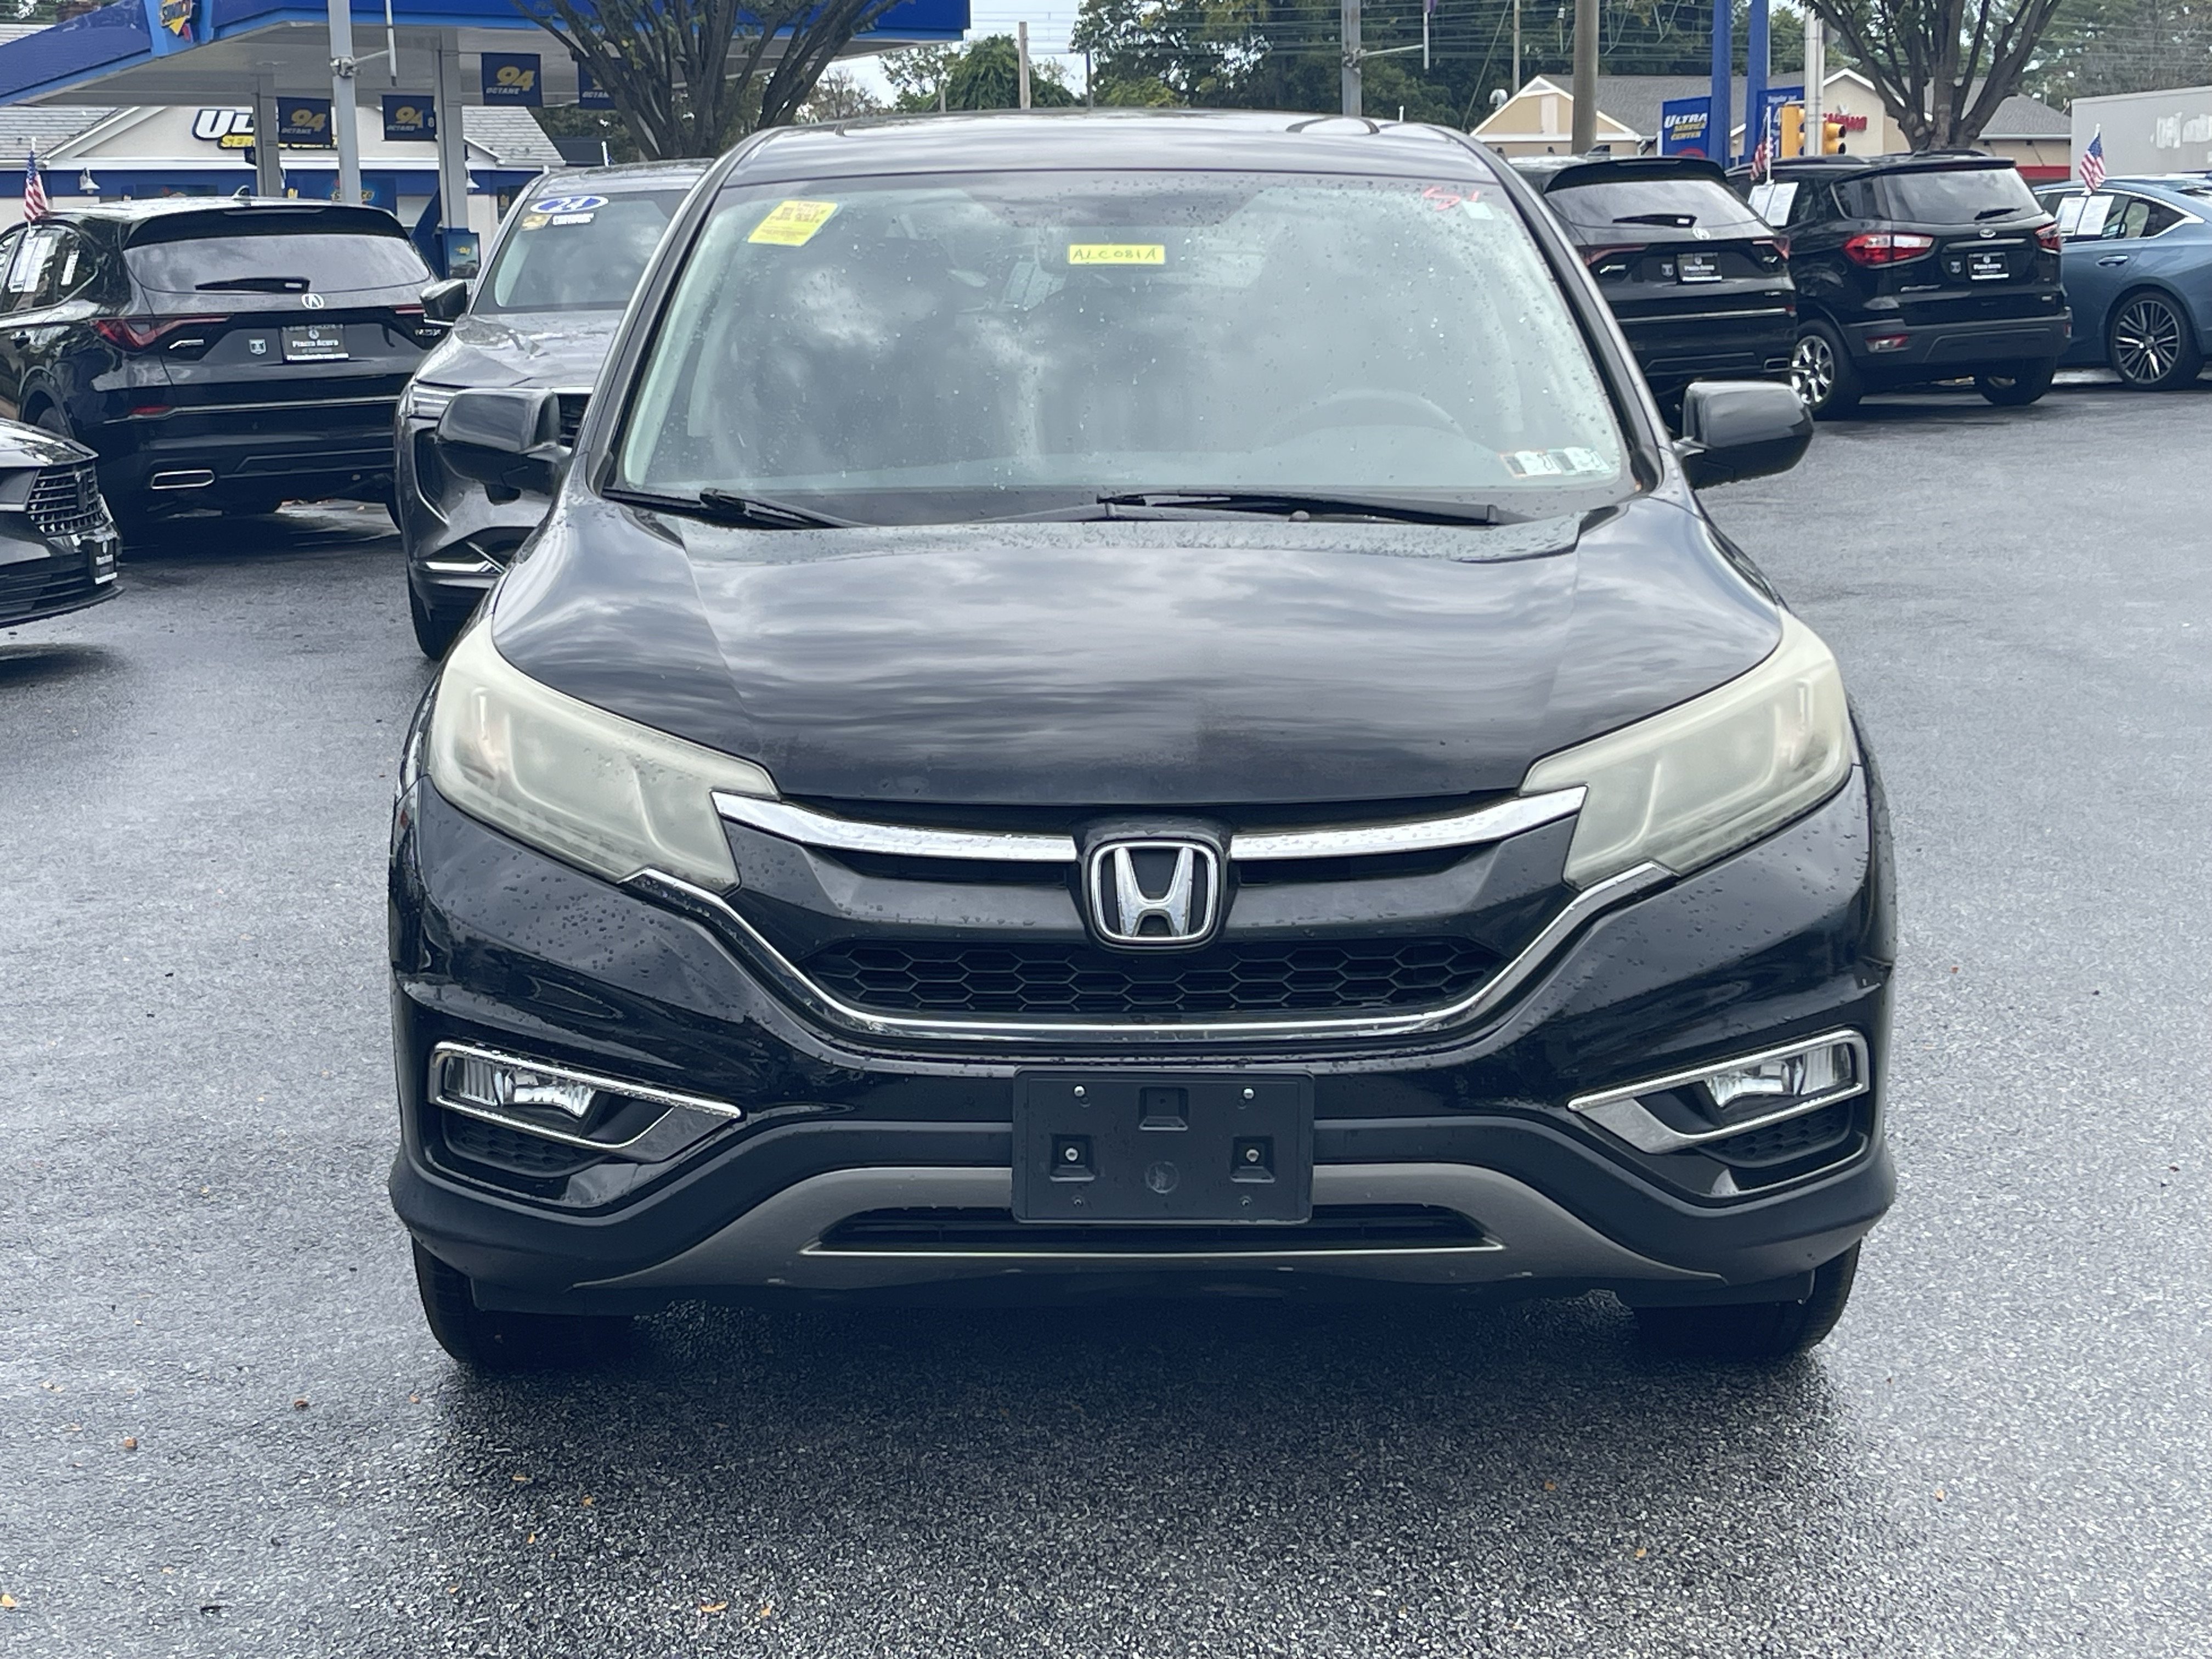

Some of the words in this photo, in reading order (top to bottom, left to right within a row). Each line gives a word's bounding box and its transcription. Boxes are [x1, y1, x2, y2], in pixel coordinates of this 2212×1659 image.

[496, 66, 535, 92] 94
[291, 109, 326, 132] 94
[396, 106, 423, 128] 94
[1664, 112, 1708, 128] ULTRA
